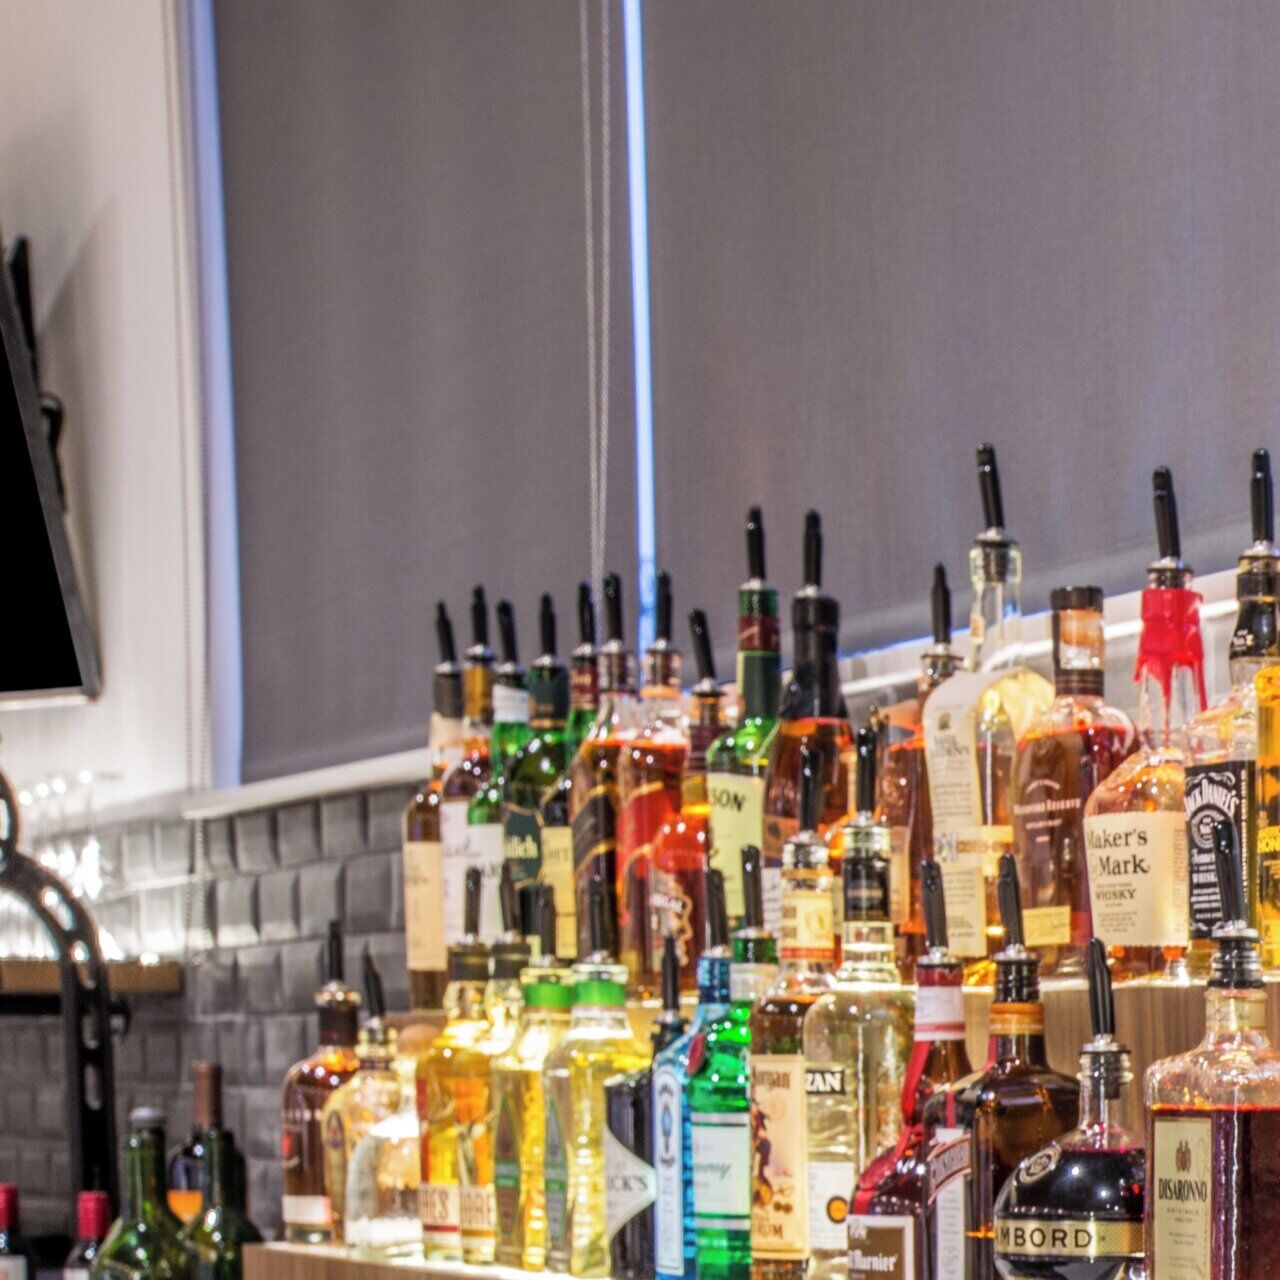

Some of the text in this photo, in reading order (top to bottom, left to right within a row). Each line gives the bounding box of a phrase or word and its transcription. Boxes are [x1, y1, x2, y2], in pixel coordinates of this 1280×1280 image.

[1099, 855, 1149, 877] Mark
[1158, 1178, 1208, 1203] DISARONNO
[1000, 1228, 1092, 1249] MBORD
